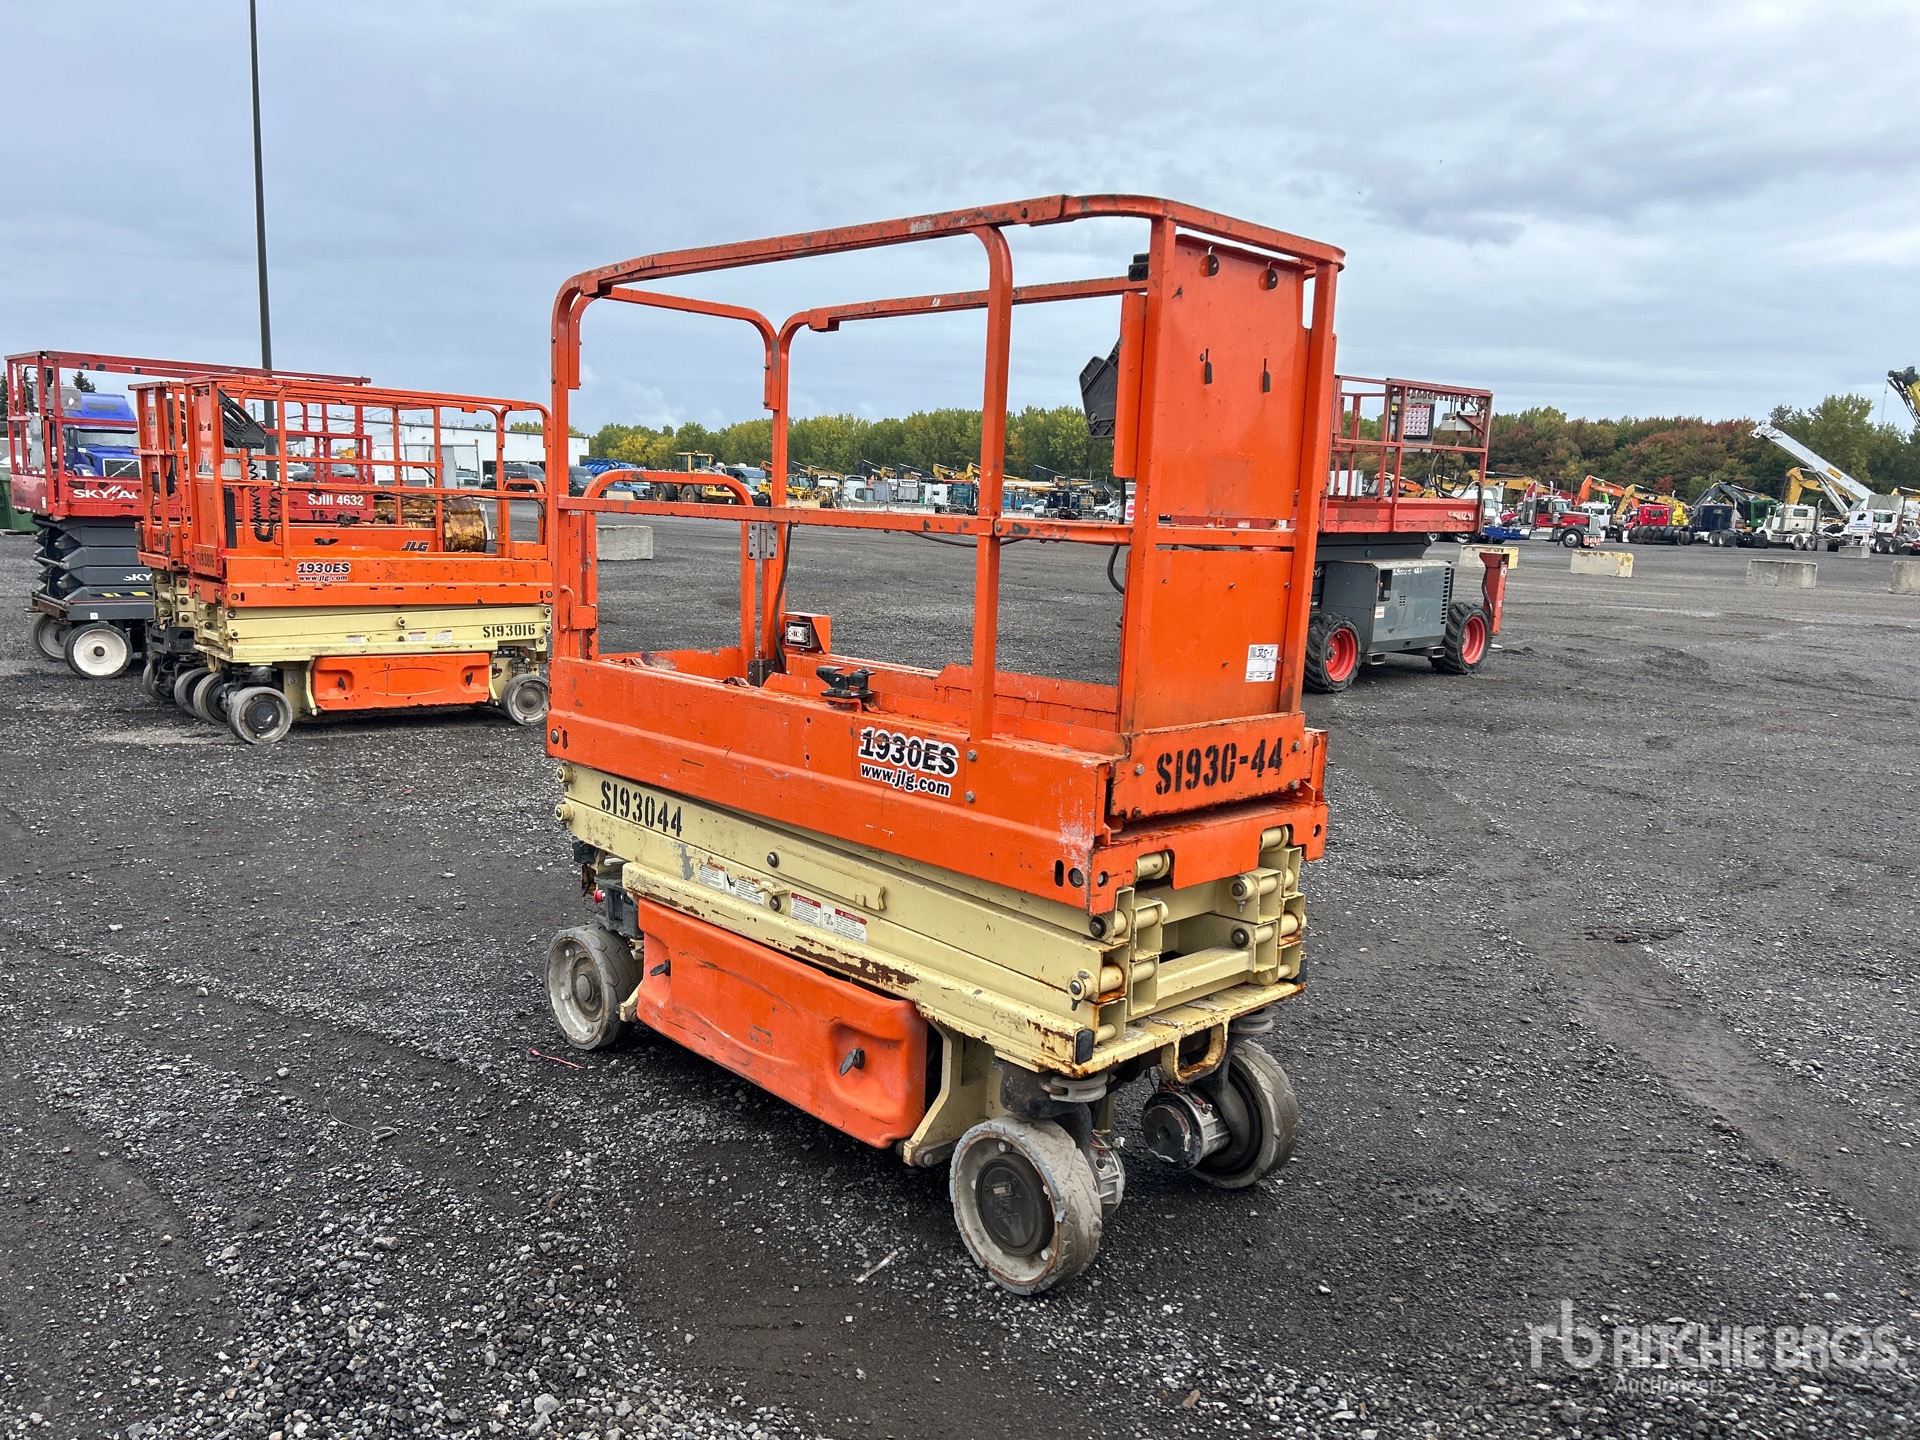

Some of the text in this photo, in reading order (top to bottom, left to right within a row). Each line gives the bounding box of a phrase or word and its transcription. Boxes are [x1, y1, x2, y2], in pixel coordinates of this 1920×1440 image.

[336, 494, 364, 506] 4632
[401, 541, 430, 552] JLG
[297, 562, 351, 573] 1930ES
[860, 729, 957, 775] 1930ES
[861, 764, 950, 797] www.jlg.com
